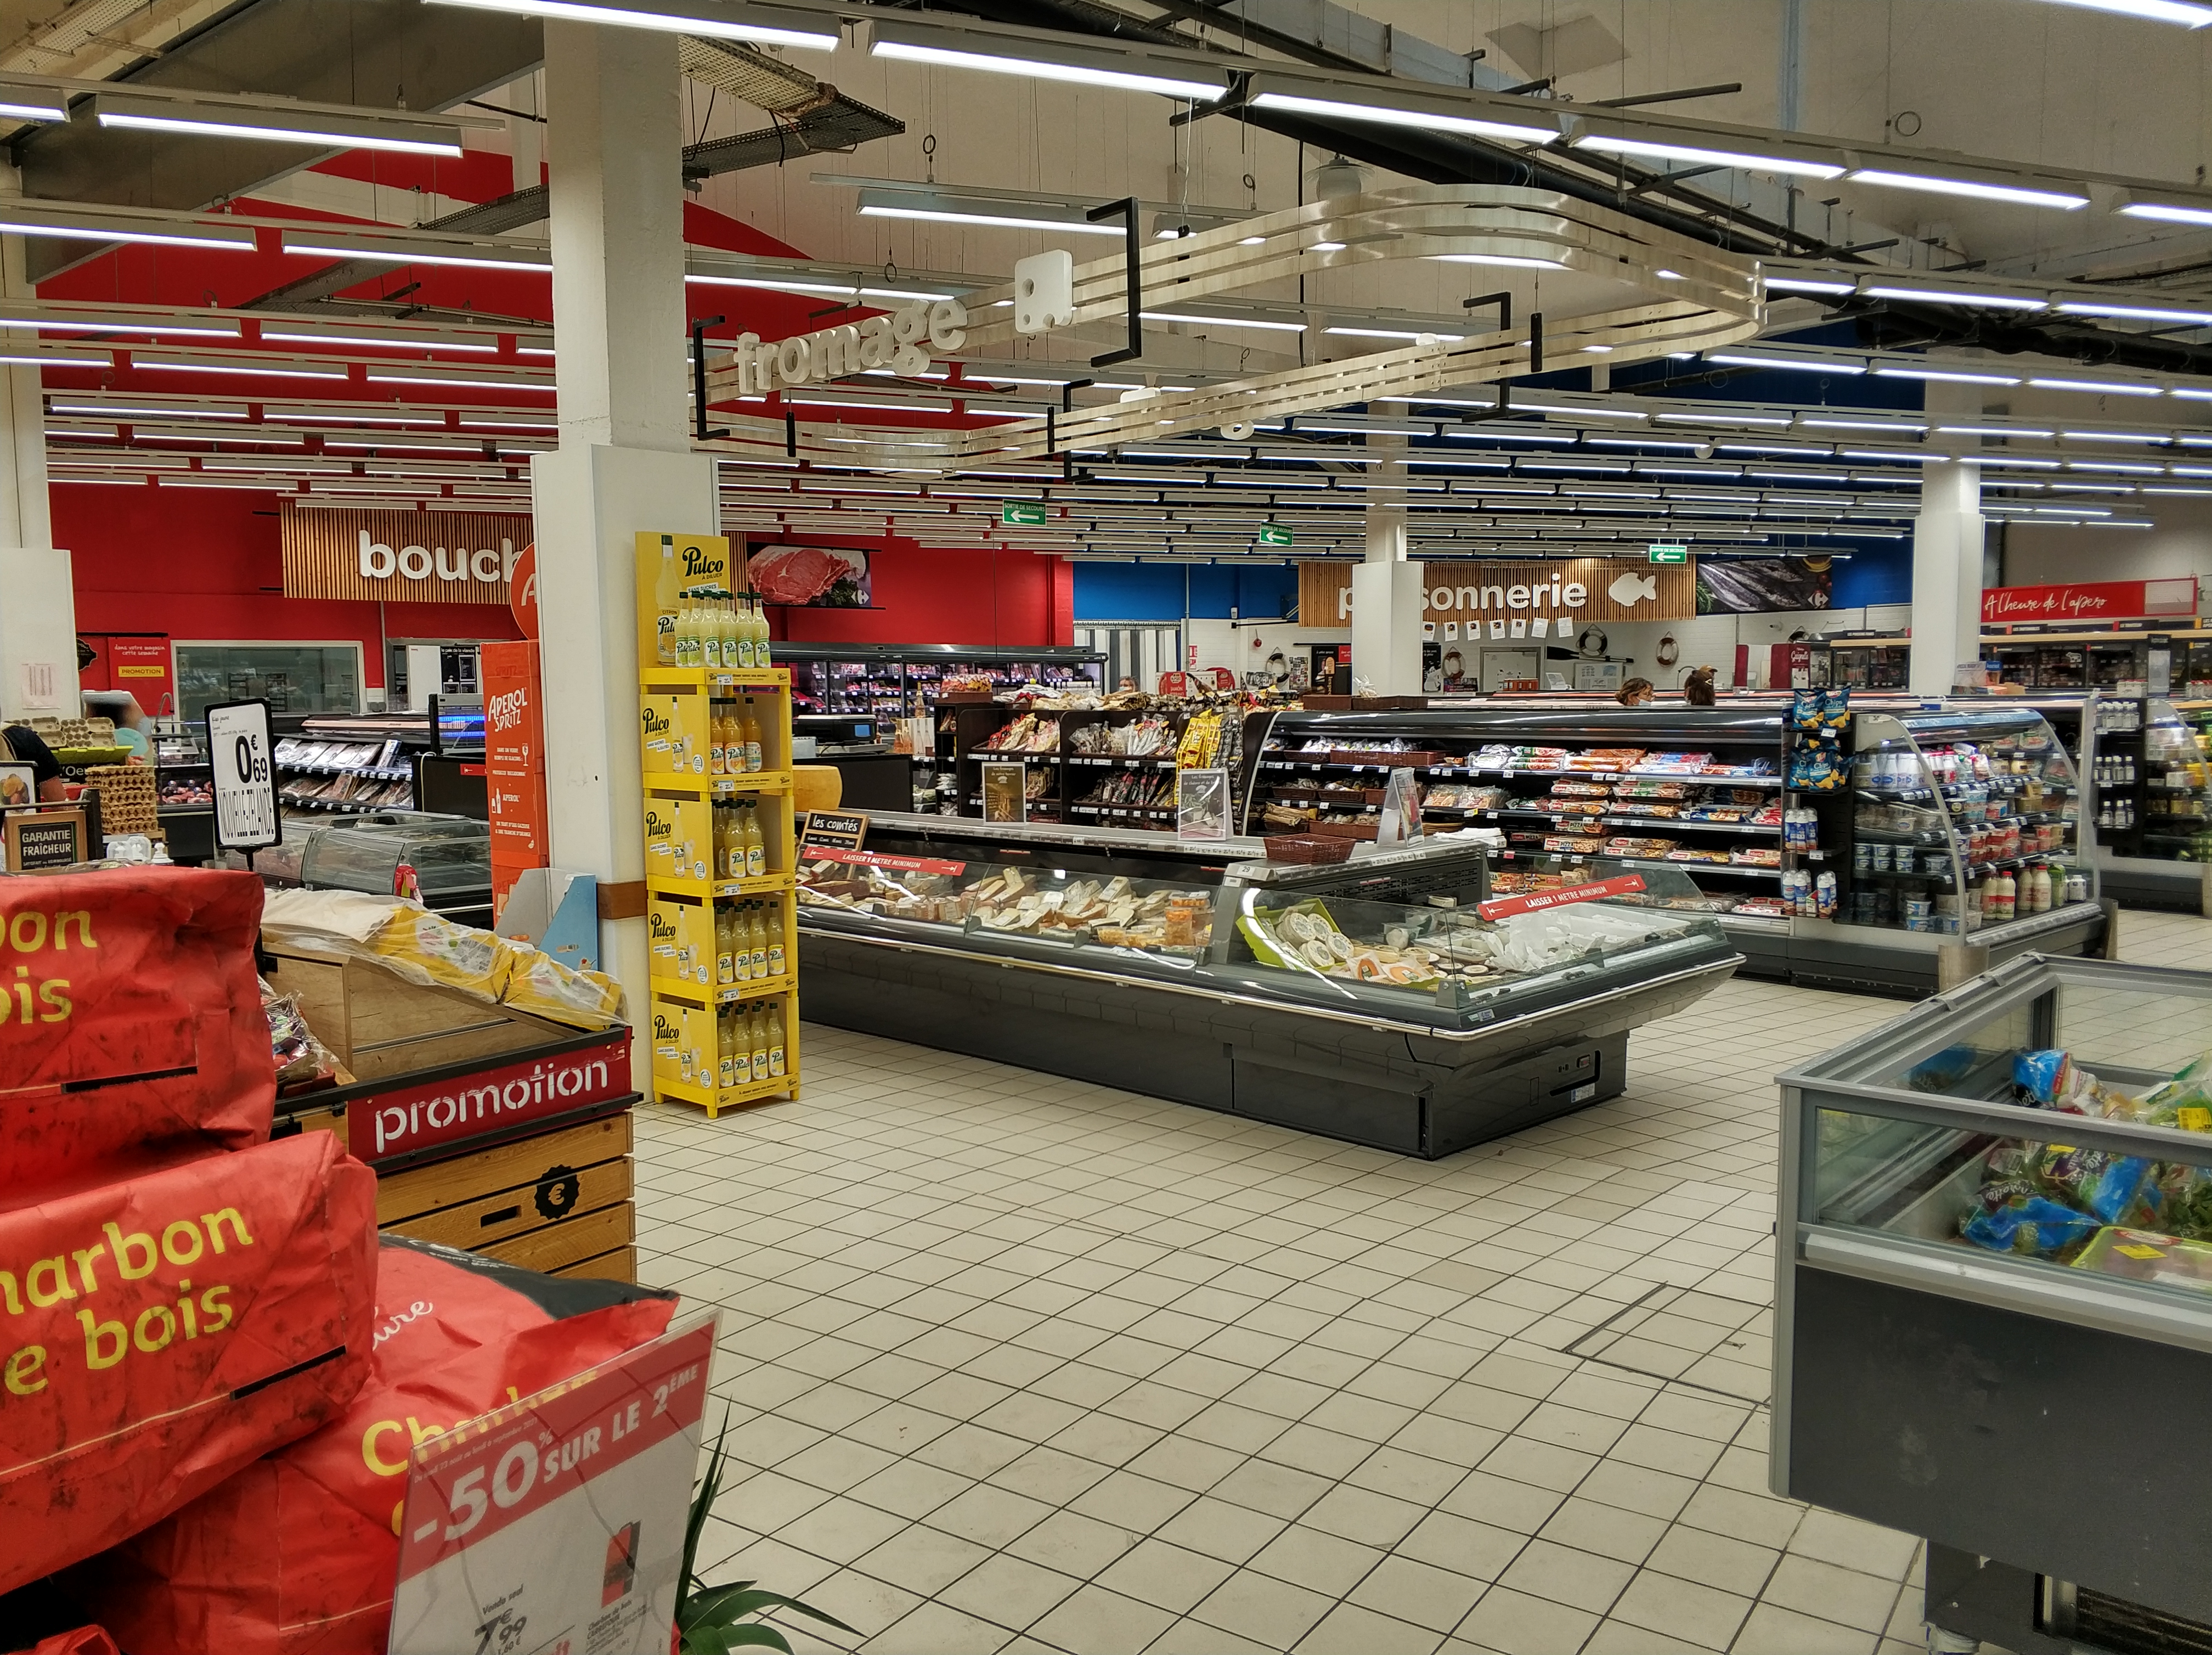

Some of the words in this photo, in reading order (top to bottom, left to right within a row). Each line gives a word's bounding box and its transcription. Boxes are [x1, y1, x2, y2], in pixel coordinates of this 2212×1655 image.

[733, 298, 968, 395] fromage
[682, 547, 724, 577] Pulco
[2043, 593, 2058, 612] de
[658, 617, 675, 634] Pul
[488, 687, 528, 722] APEROL
[495, 709, 521, 733] SPRITZ
[642, 708, 669, 734] Pulco
[251, 734, 258, 750] €
[235, 735, 252, 784] 0
[253, 757, 268, 783] 69
[646, 812, 671, 837] Pulco
[812, 814, 825, 828] les
[826, 819, 859, 832] comtés
[22, 830, 71, 843] GARANTIE
[23, 843, 71, 857] FRAÎCHEUR
[842, 853, 866, 863] LAISSER
[871, 857, 892, 866] METRE
[891, 859, 922, 869] MINIMUM
[1525, 896, 1552, 908] LAISSER
[1559, 891, 1578, 902] METRE
[1579, 885, 1608, 898] MINIMUM
[651, 913, 676, 938] Pulco
[0, 966, 72, 1024] is
[654, 1015, 679, 1040] Pulco
[375, 1060, 607, 1153] promotion
[76, 1279, 233, 1370] bois
[544, 1427, 601, 1483] SUR
[612, 1400, 641, 1442] LE
[482, 1597, 506, 1615] Vendu
[508, 1583, 524, 1601] seul
[499, 1615, 527, 1645] 99
